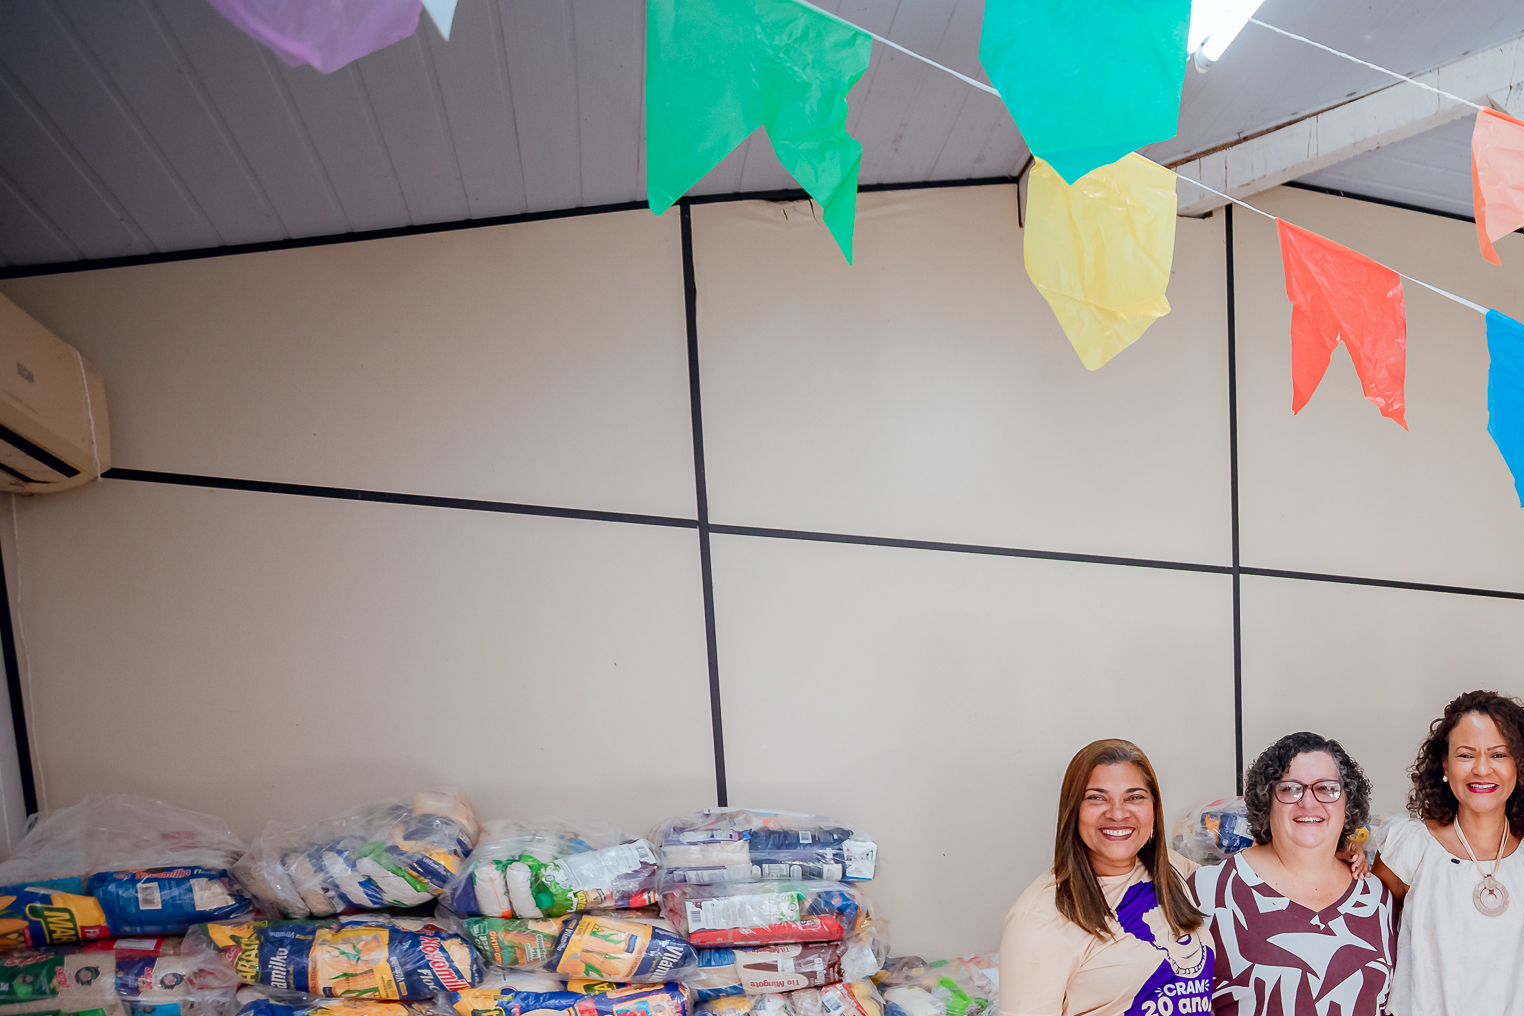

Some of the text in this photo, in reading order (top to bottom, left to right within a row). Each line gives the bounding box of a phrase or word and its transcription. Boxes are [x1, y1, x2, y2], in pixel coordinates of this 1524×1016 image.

[750, 979, 800, 989] Tio Mingote
[1163, 979, 1205, 997] CRAM
